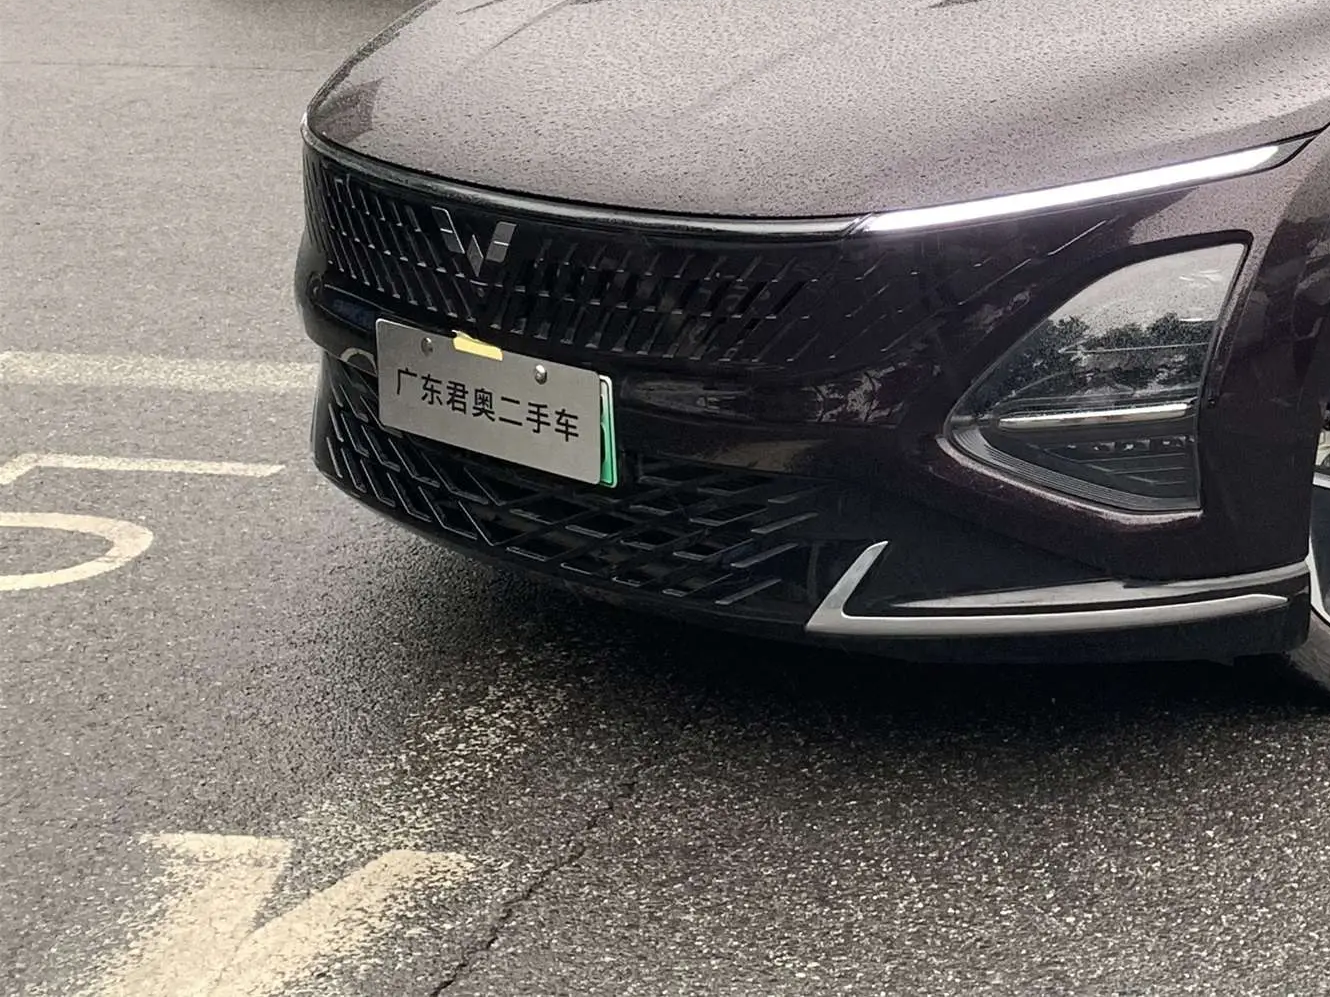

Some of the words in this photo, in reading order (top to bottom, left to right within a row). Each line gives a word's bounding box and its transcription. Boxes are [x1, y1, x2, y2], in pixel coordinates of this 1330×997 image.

[396, 368, 579, 442] 广东君奥二手车
